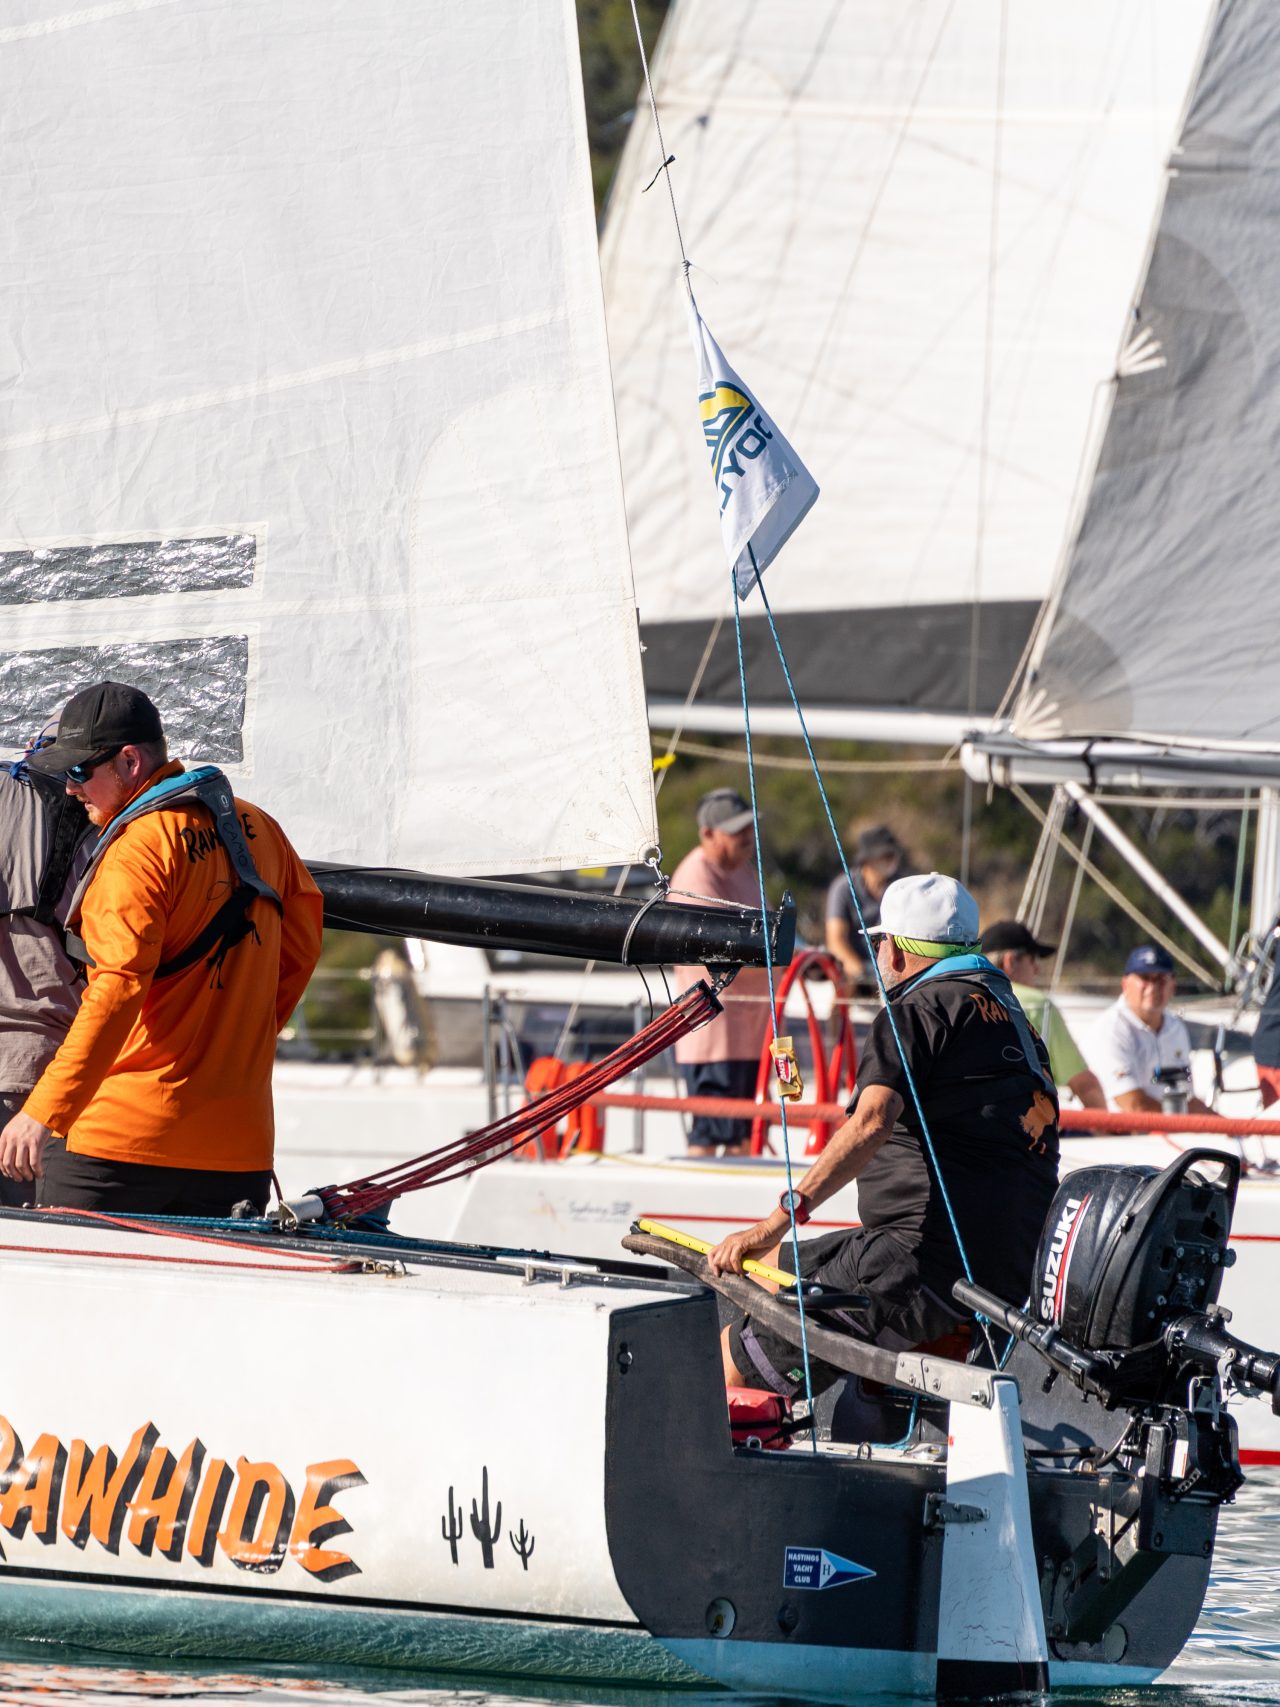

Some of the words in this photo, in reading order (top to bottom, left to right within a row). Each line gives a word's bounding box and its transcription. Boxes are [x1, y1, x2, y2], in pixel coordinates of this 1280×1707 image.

[222, 822, 249, 868] CAMO
[1041, 1198, 1081, 1320] SUZUKI
[788, 1553, 820, 1562] HASTINGS
[793, 1564, 813, 1573] YACHT
[822, 1564, 831, 1576] H
[794, 1575, 811, 1584] CLUB
